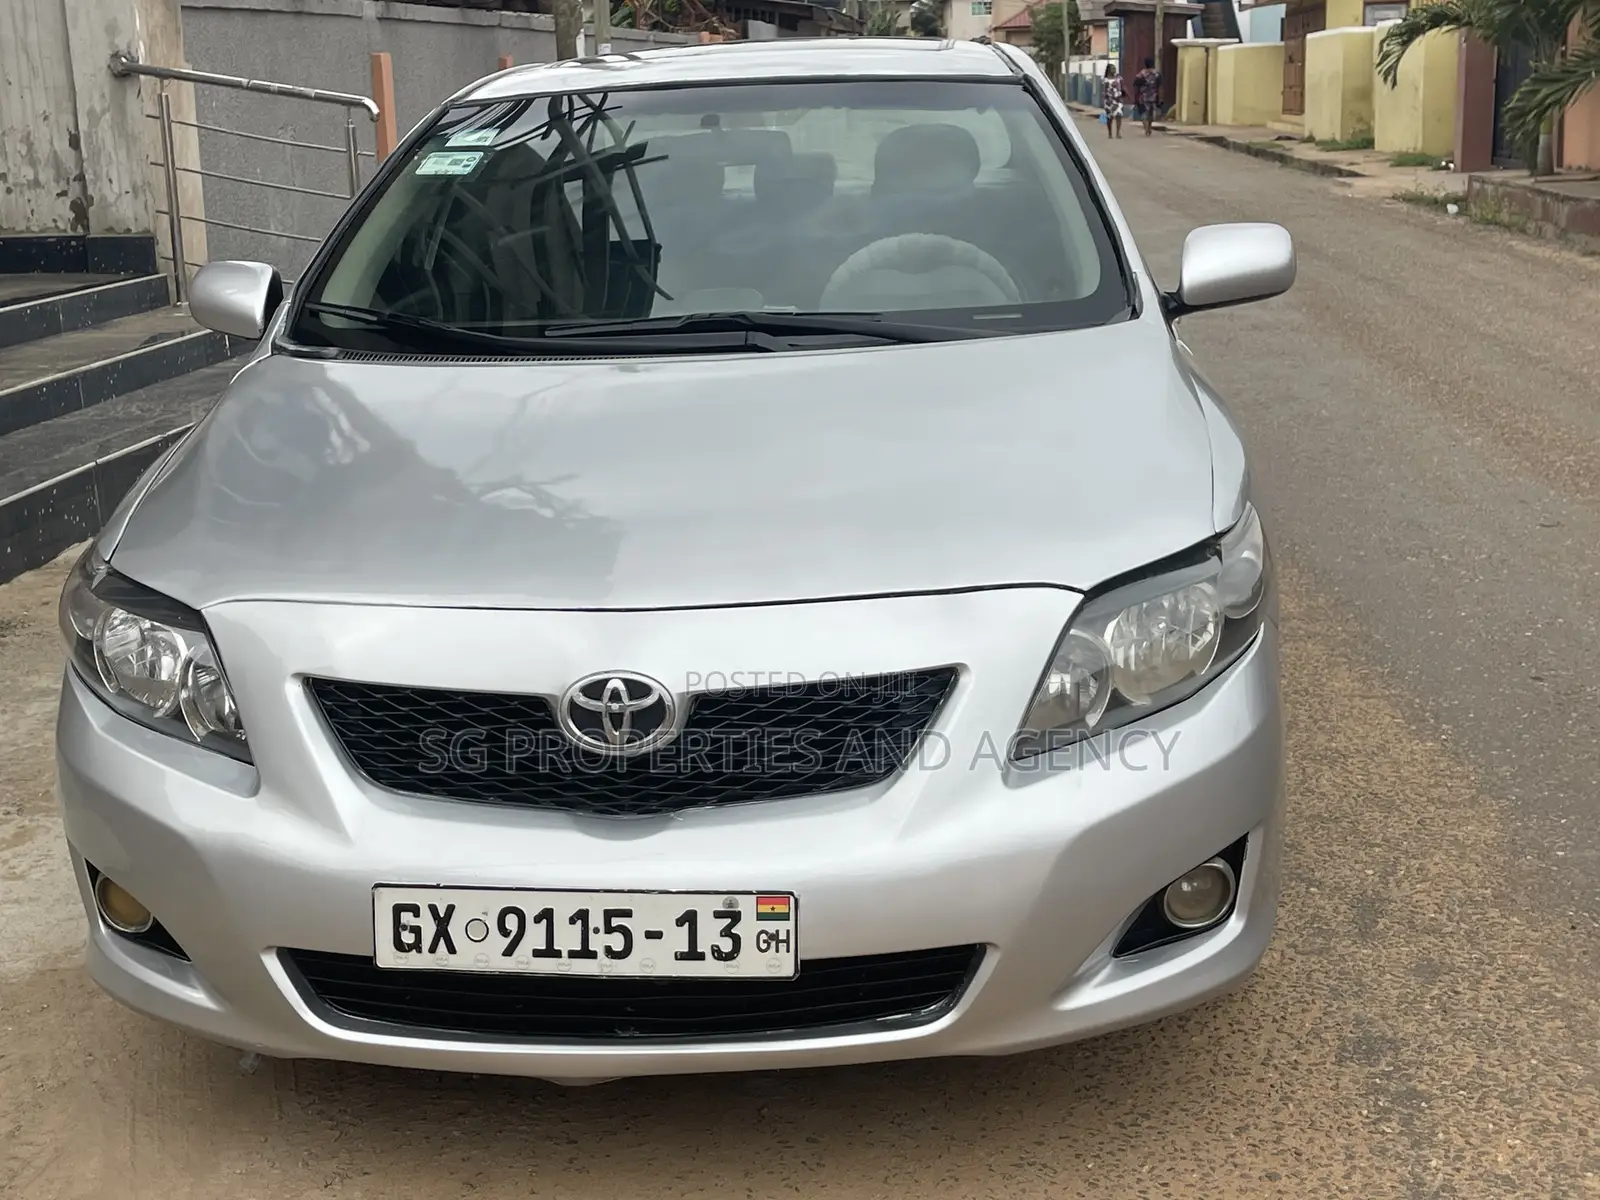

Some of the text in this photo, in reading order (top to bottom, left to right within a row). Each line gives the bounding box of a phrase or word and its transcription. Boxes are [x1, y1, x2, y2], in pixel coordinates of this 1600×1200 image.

[391, 902, 742, 962] GX 9115-13
[756, 928, 790, 954] GH
